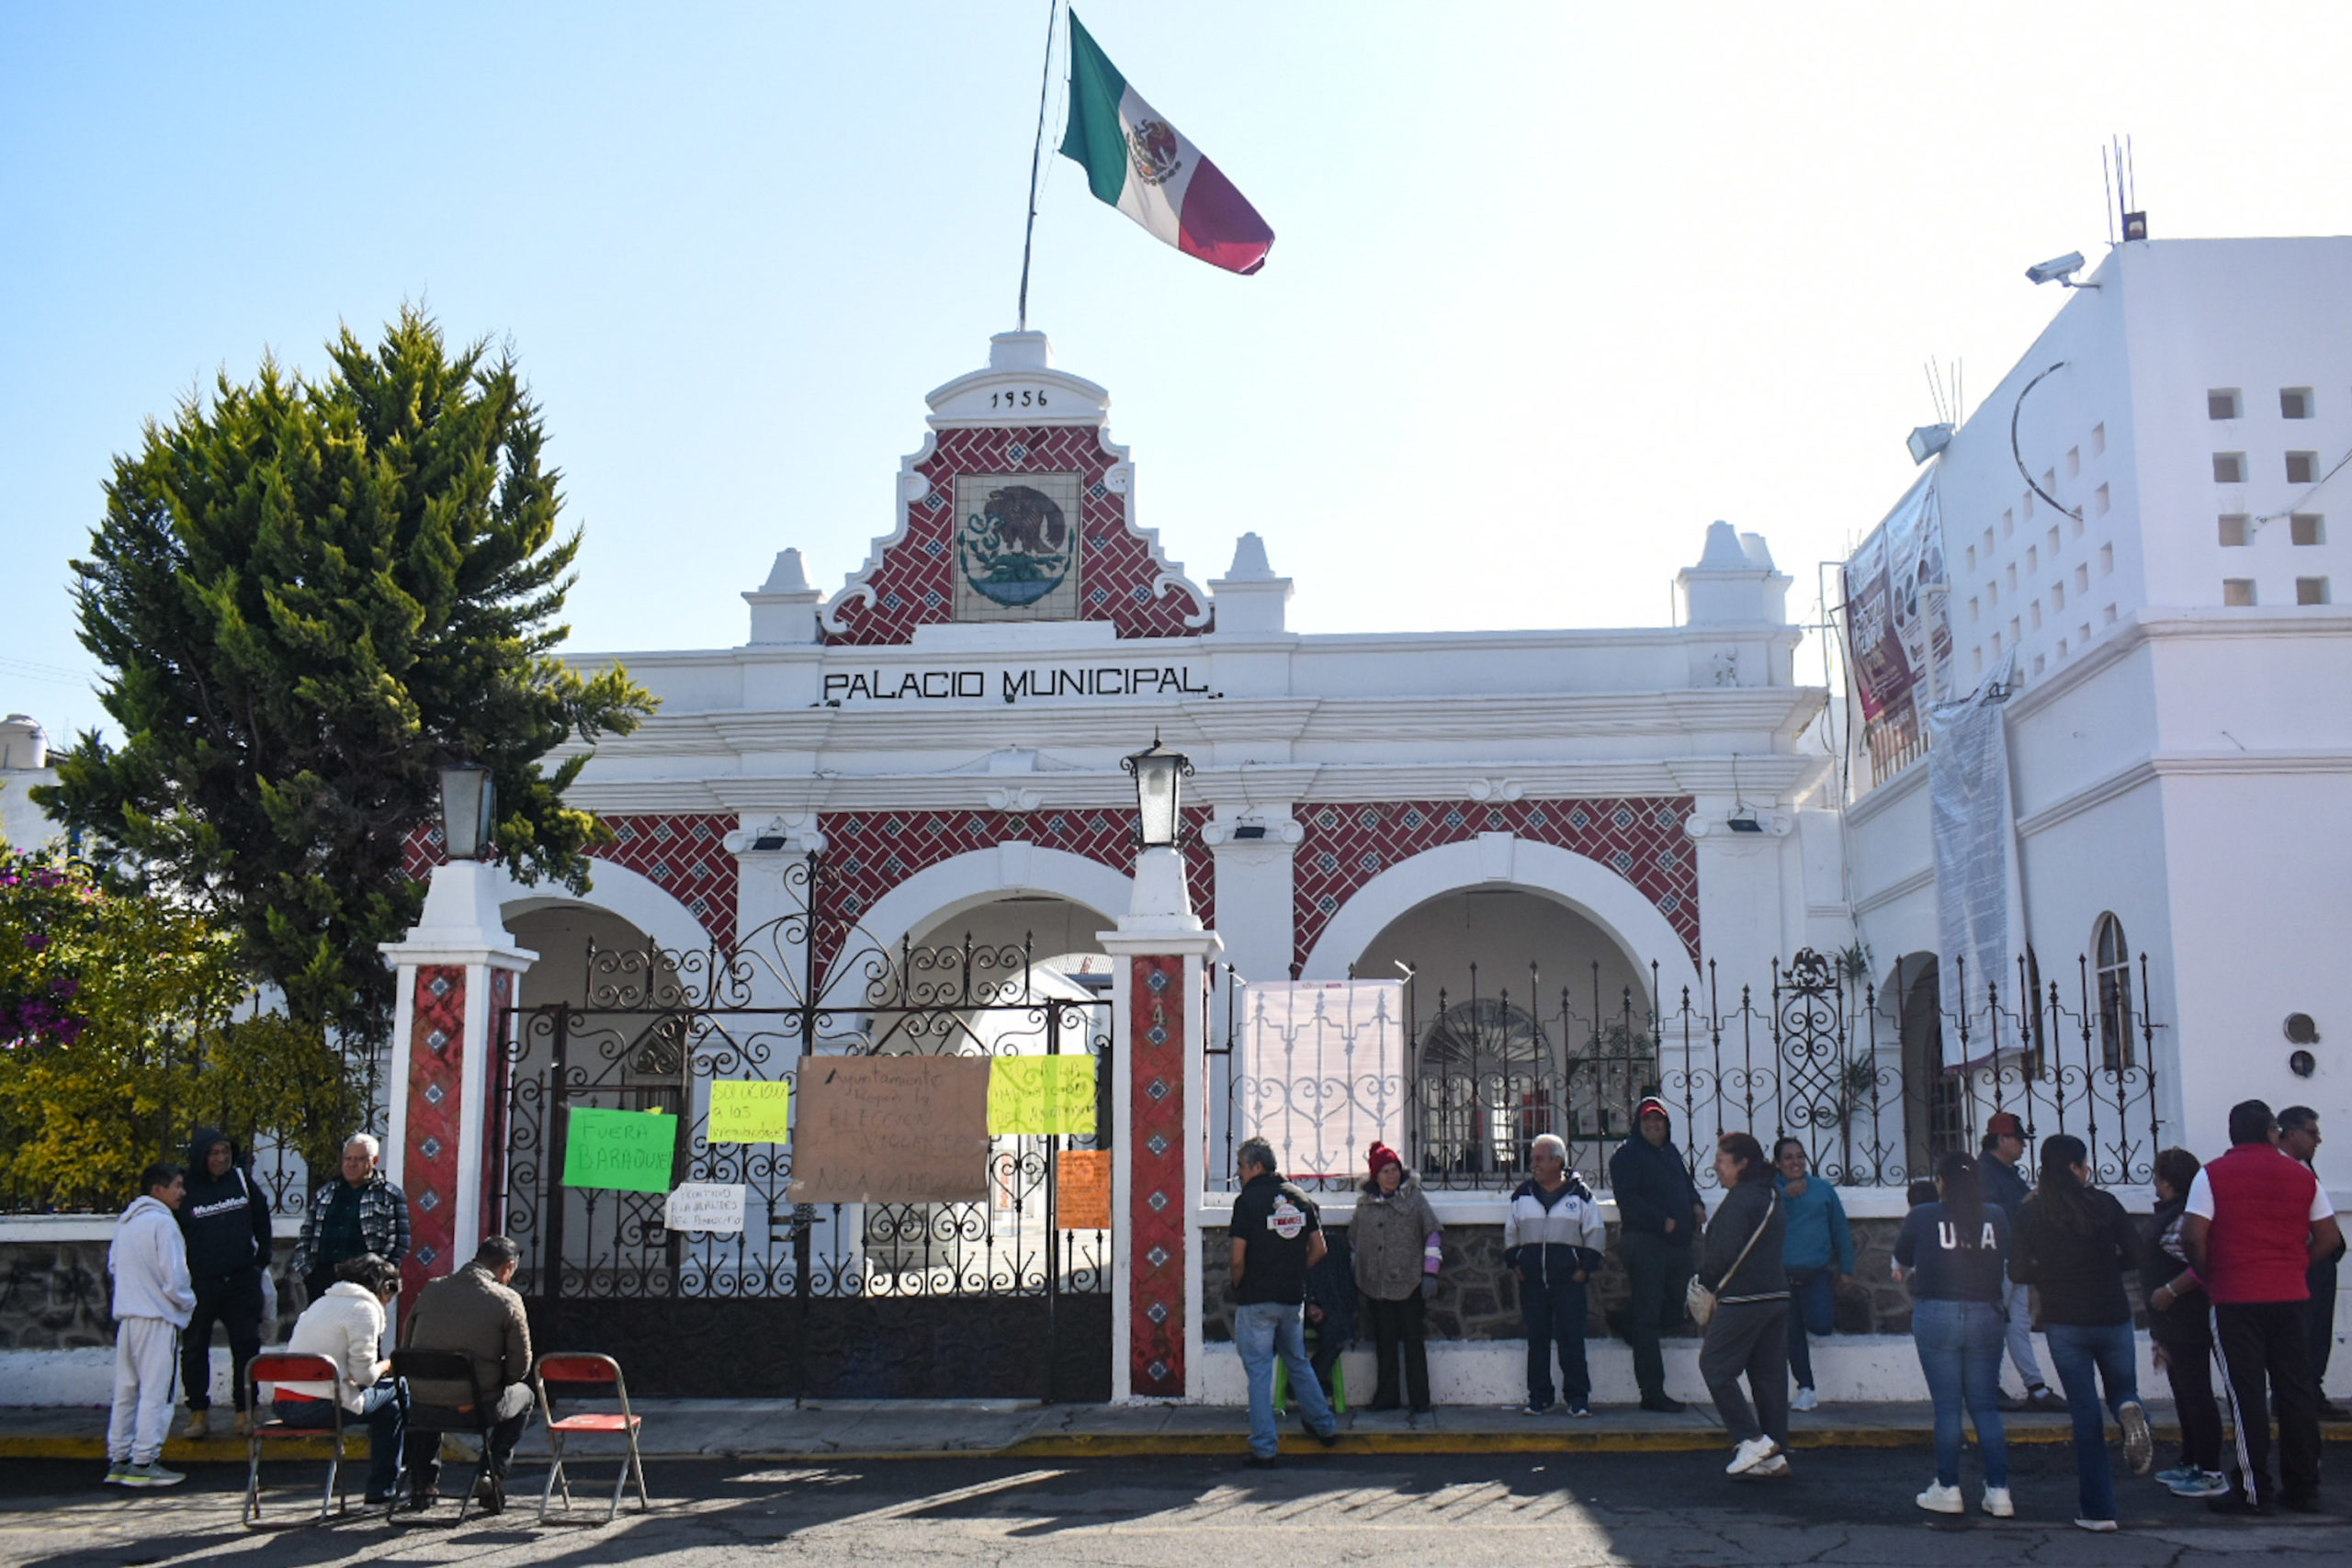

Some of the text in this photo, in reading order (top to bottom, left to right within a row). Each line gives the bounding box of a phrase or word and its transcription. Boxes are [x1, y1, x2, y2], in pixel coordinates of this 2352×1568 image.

[990, 389, 1048, 409] 1956
[824, 667, 1209, 700] PALACIO MUNICIPAL
[1938, 1220, 1998, 1250] UA
